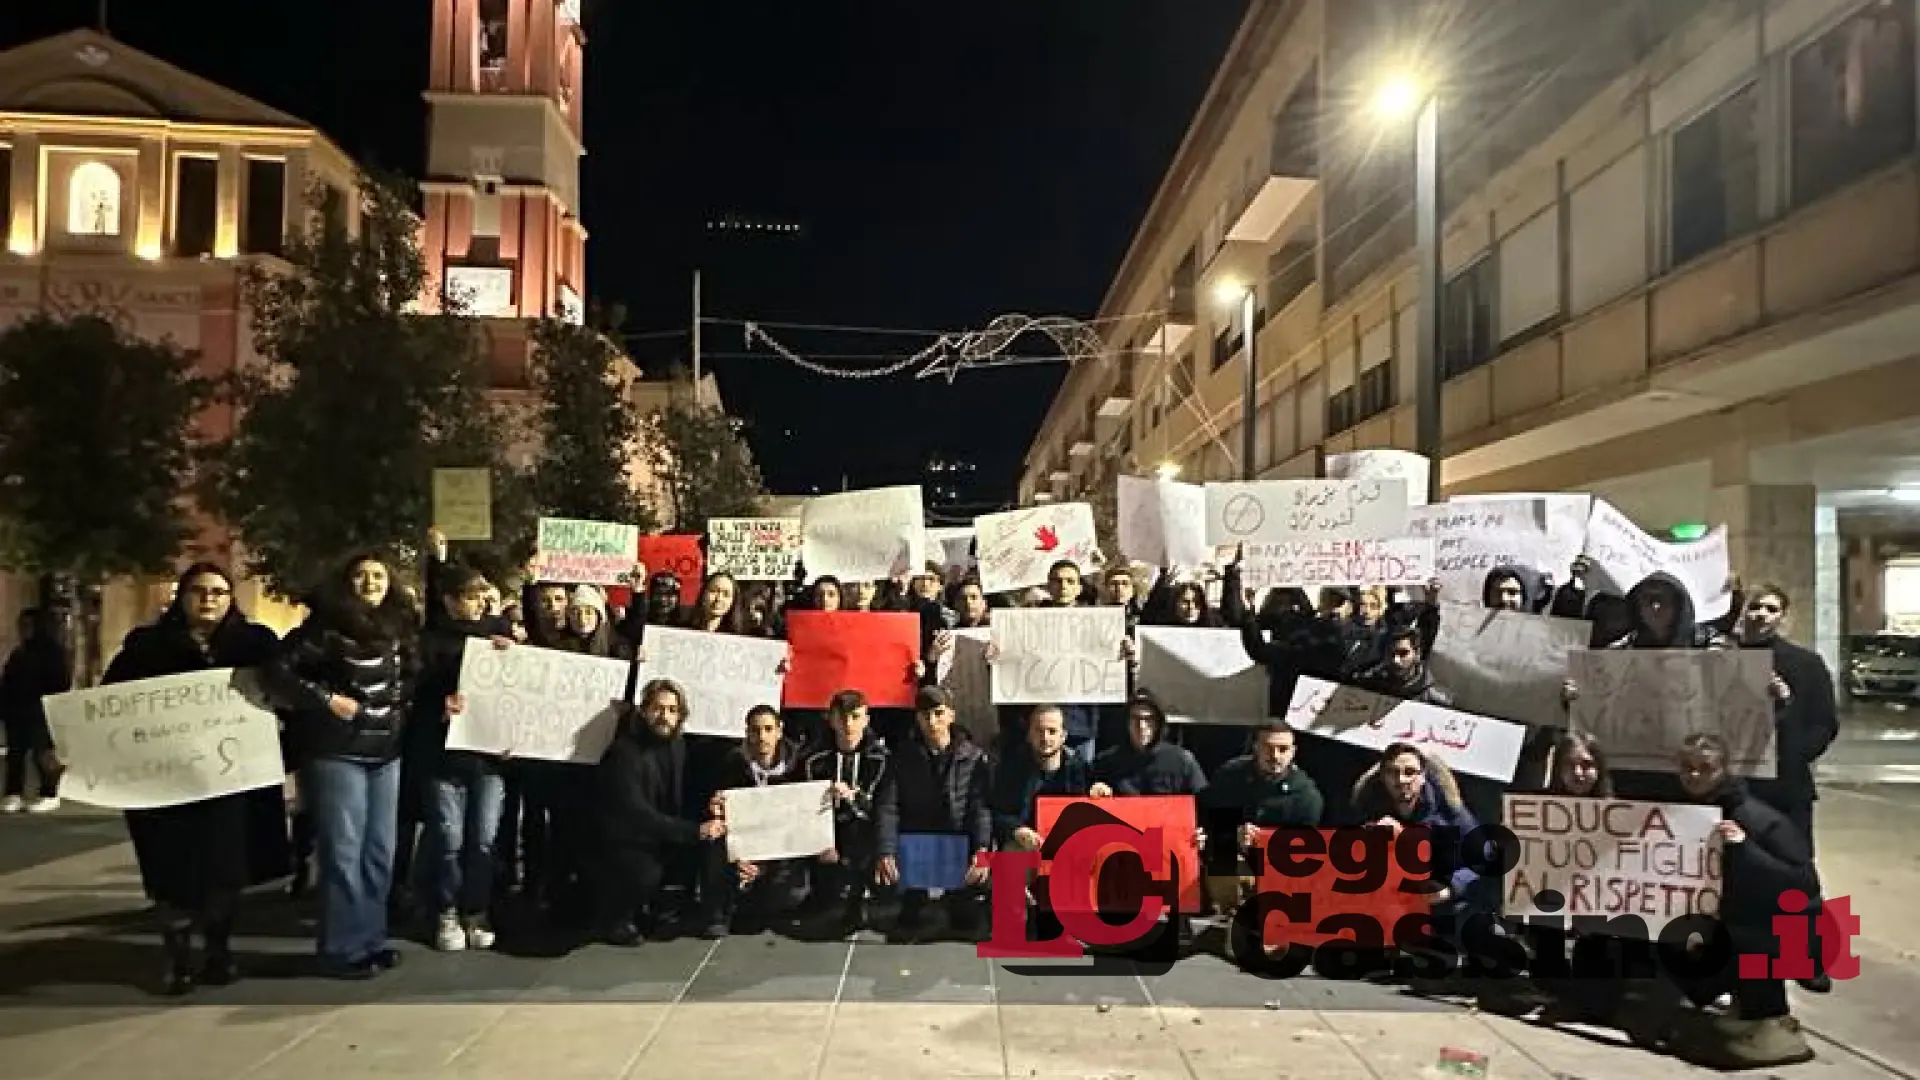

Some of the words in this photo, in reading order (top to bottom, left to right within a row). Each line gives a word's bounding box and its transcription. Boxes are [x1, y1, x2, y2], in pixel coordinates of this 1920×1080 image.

[998, 656, 1123, 699] UCCIDE
[1510, 800, 1676, 841] EDUCA
[1517, 835, 1598, 870] TUO
[1615, 837, 1723, 881] FIGLIO
[1569, 872, 1722, 918] RISPETTO
